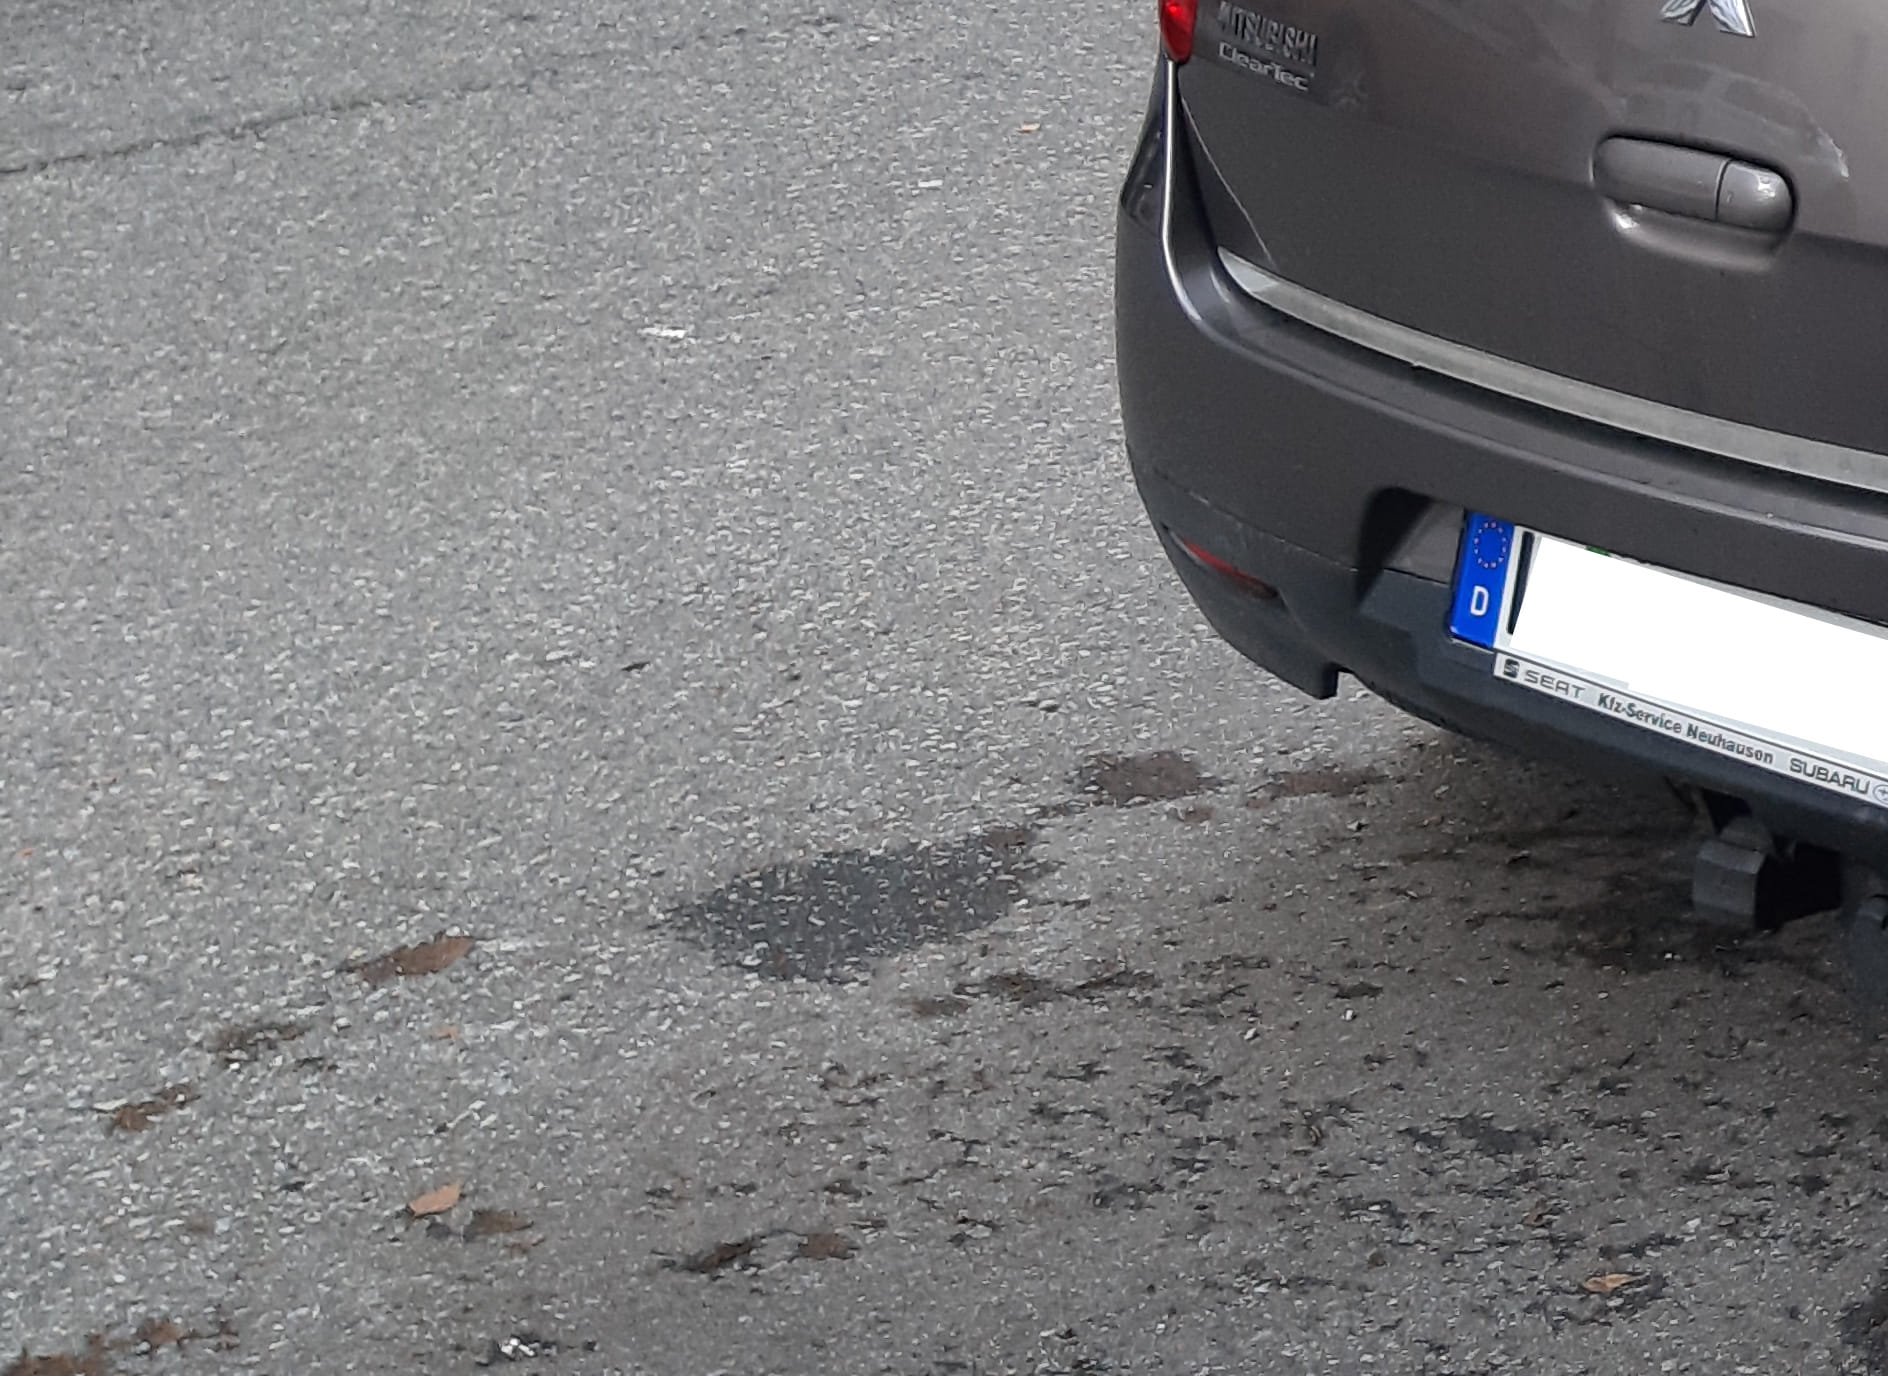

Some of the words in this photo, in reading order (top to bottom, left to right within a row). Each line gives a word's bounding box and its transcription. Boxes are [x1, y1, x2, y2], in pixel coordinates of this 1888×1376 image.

[1470, 585, 1489, 616] D
[1524, 669, 1586, 699] SEAT
[1598, 692, 1682, 734] Kfz-Service
[1789, 757, 1871, 795] SUBARU
